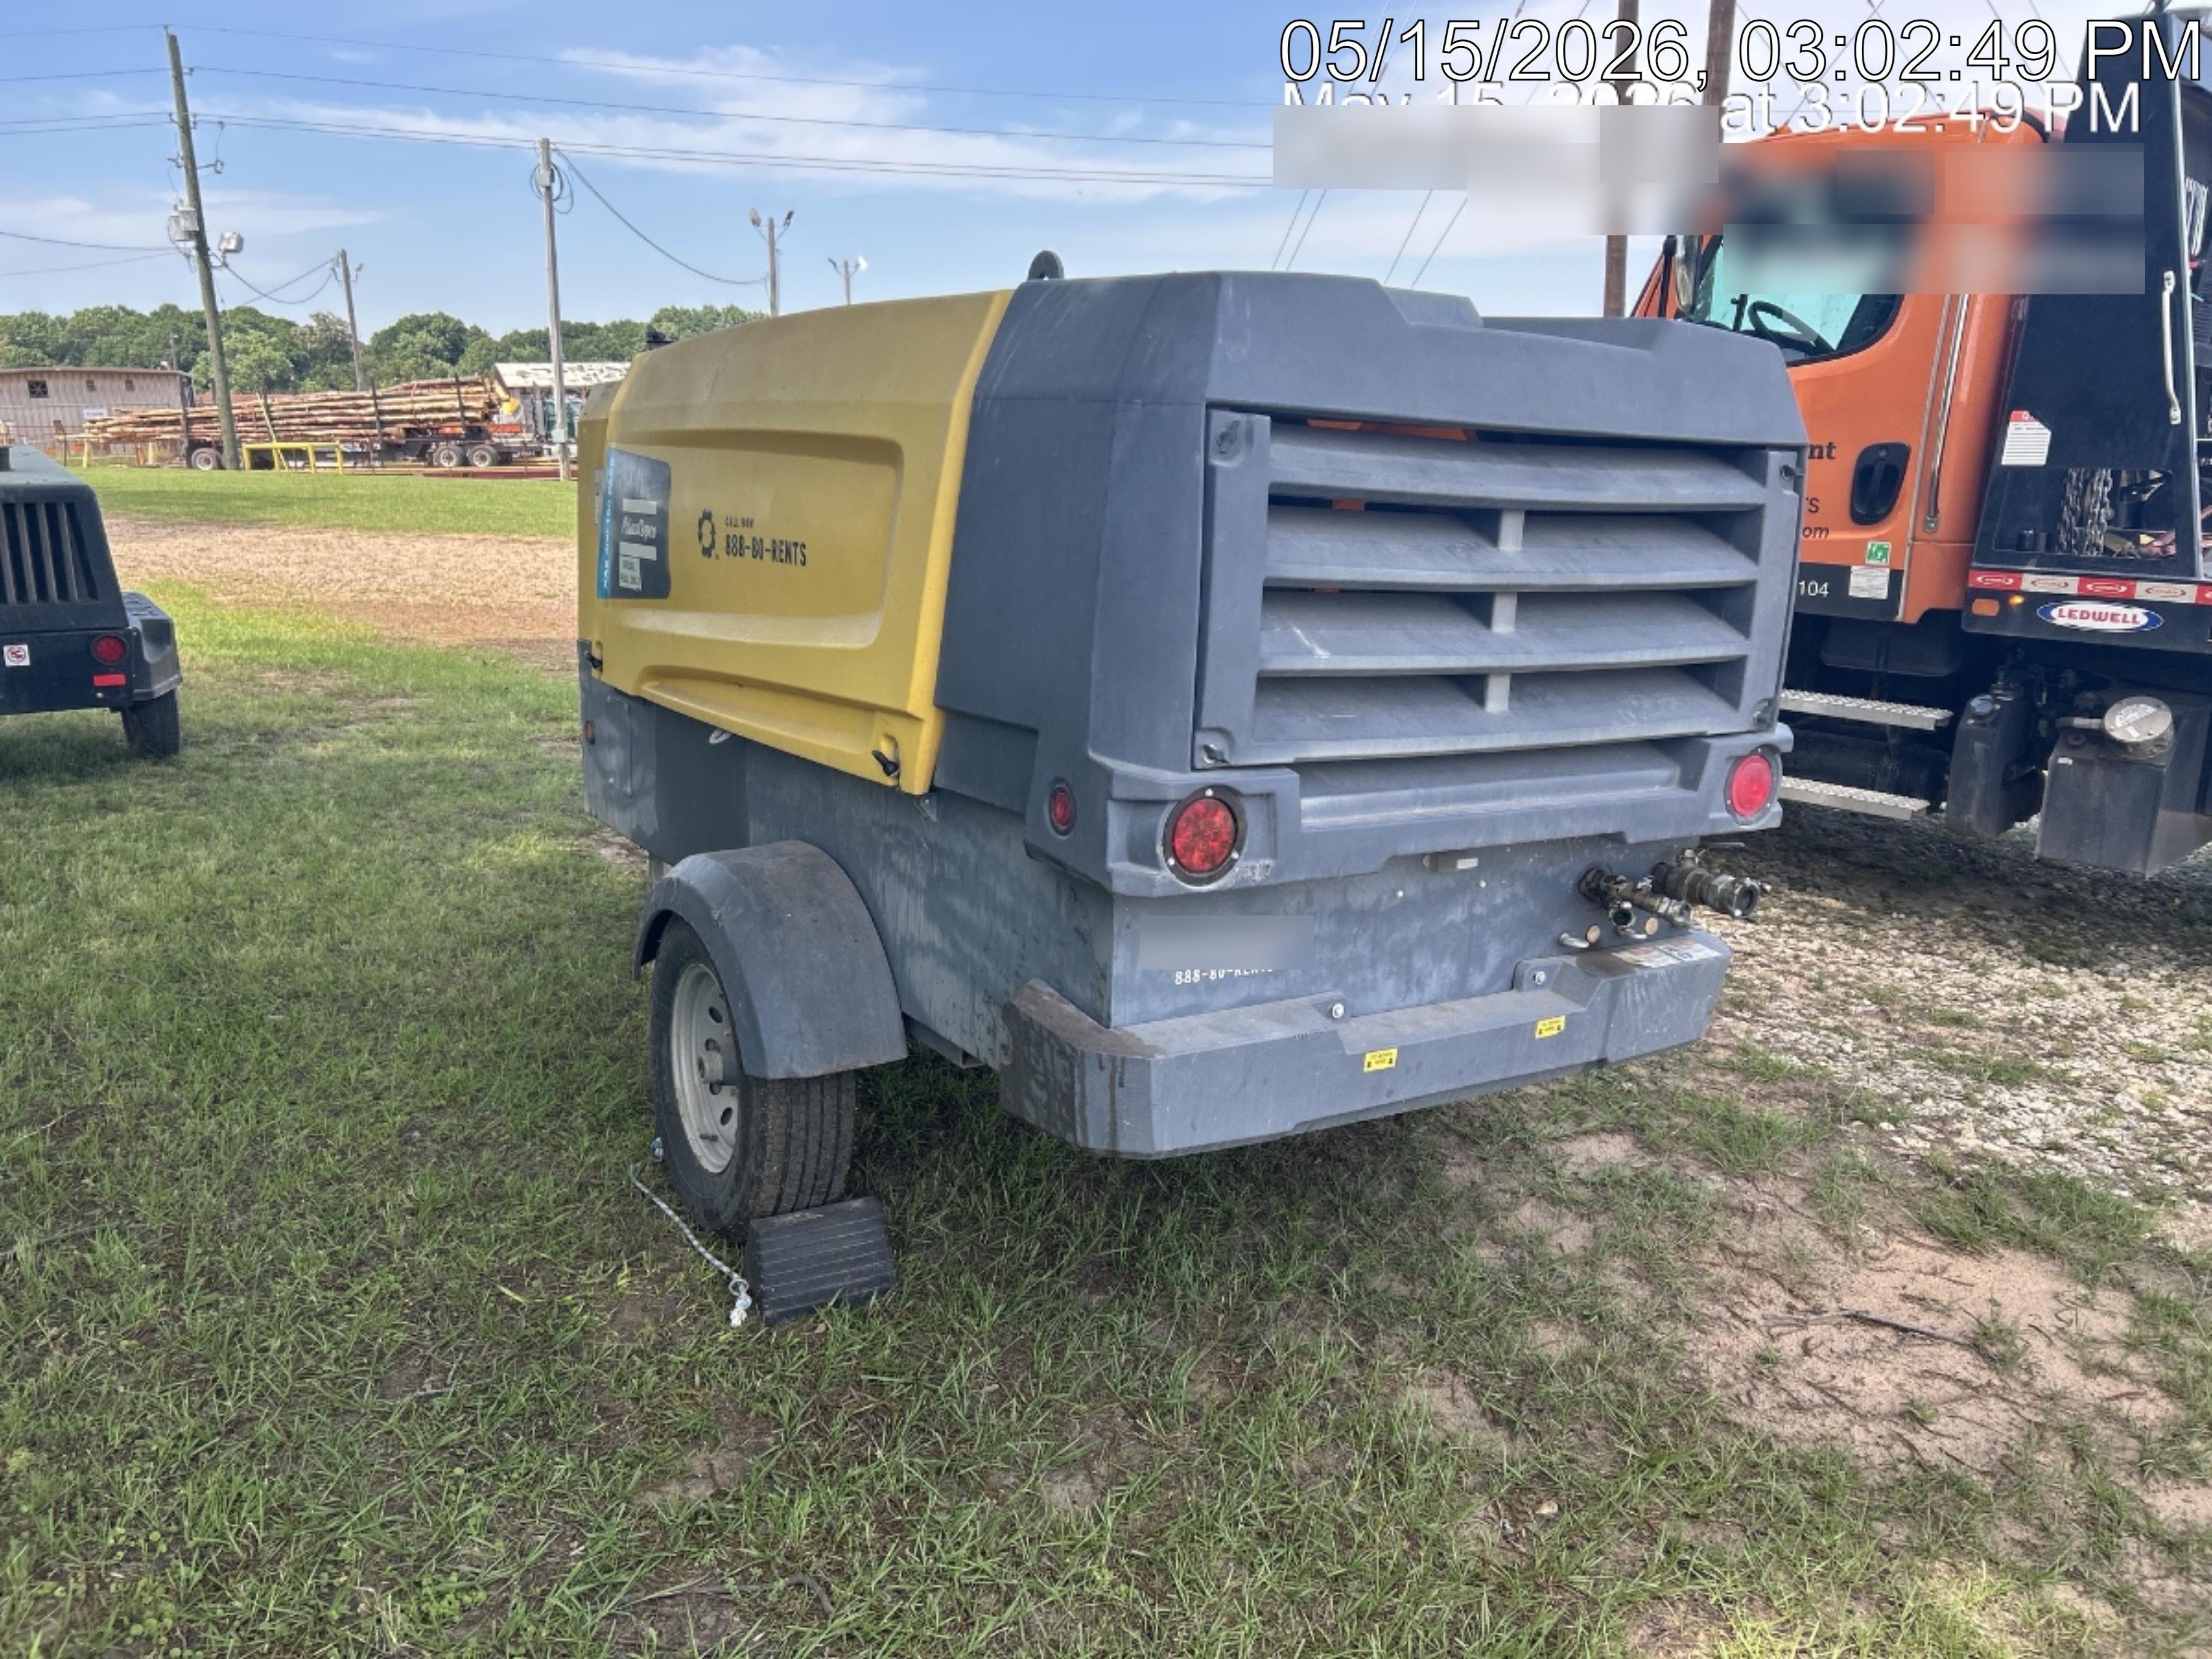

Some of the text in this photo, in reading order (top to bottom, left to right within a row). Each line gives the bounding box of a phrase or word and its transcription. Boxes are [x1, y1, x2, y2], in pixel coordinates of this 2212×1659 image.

[726, 534, 807, 567] 888-80-RENTS
[1798, 580, 1829, 597] 104
[2058, 608, 2141, 624] LEDWELL
